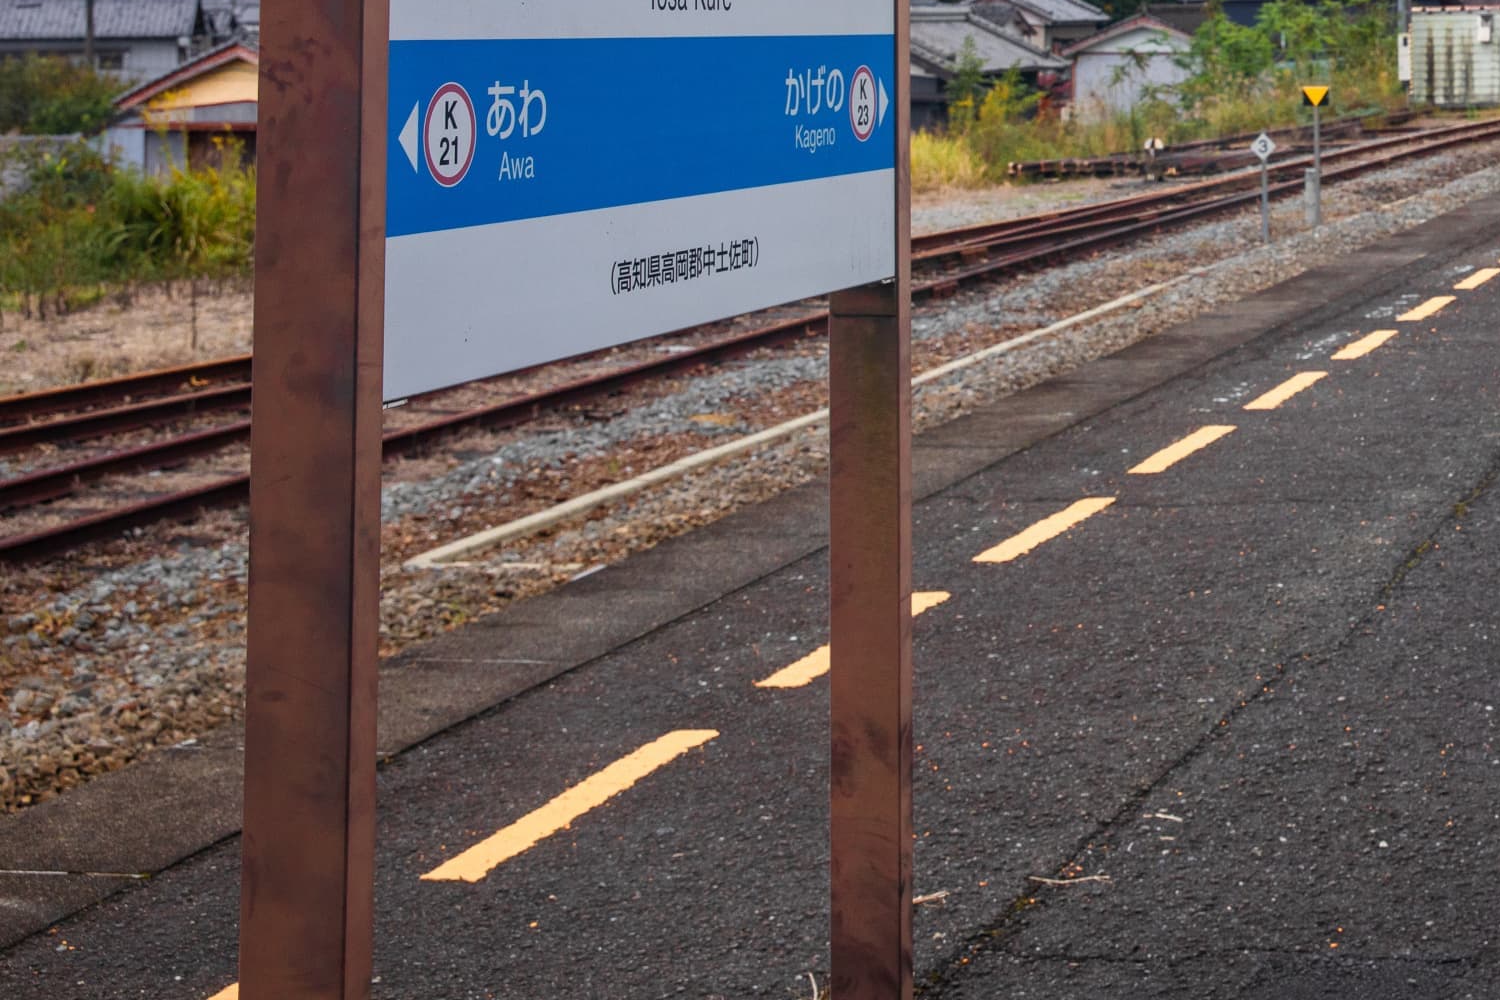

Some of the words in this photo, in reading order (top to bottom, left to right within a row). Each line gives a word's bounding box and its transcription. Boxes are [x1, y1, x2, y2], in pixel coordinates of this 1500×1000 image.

[785, 64, 845, 116] かげの
[859, 78, 868, 100] K
[444, 100, 458, 130] K
[486, 79, 547, 140] あわ
[857, 105, 869, 126] 23
[439, 136, 459, 166] 21
[795, 124, 836, 154] Kageno
[1258, 139, 1268, 153] 3
[498, 151, 536, 182] Awa
[610, 236, 760, 295] (高知県高岡郡中土佐町)
